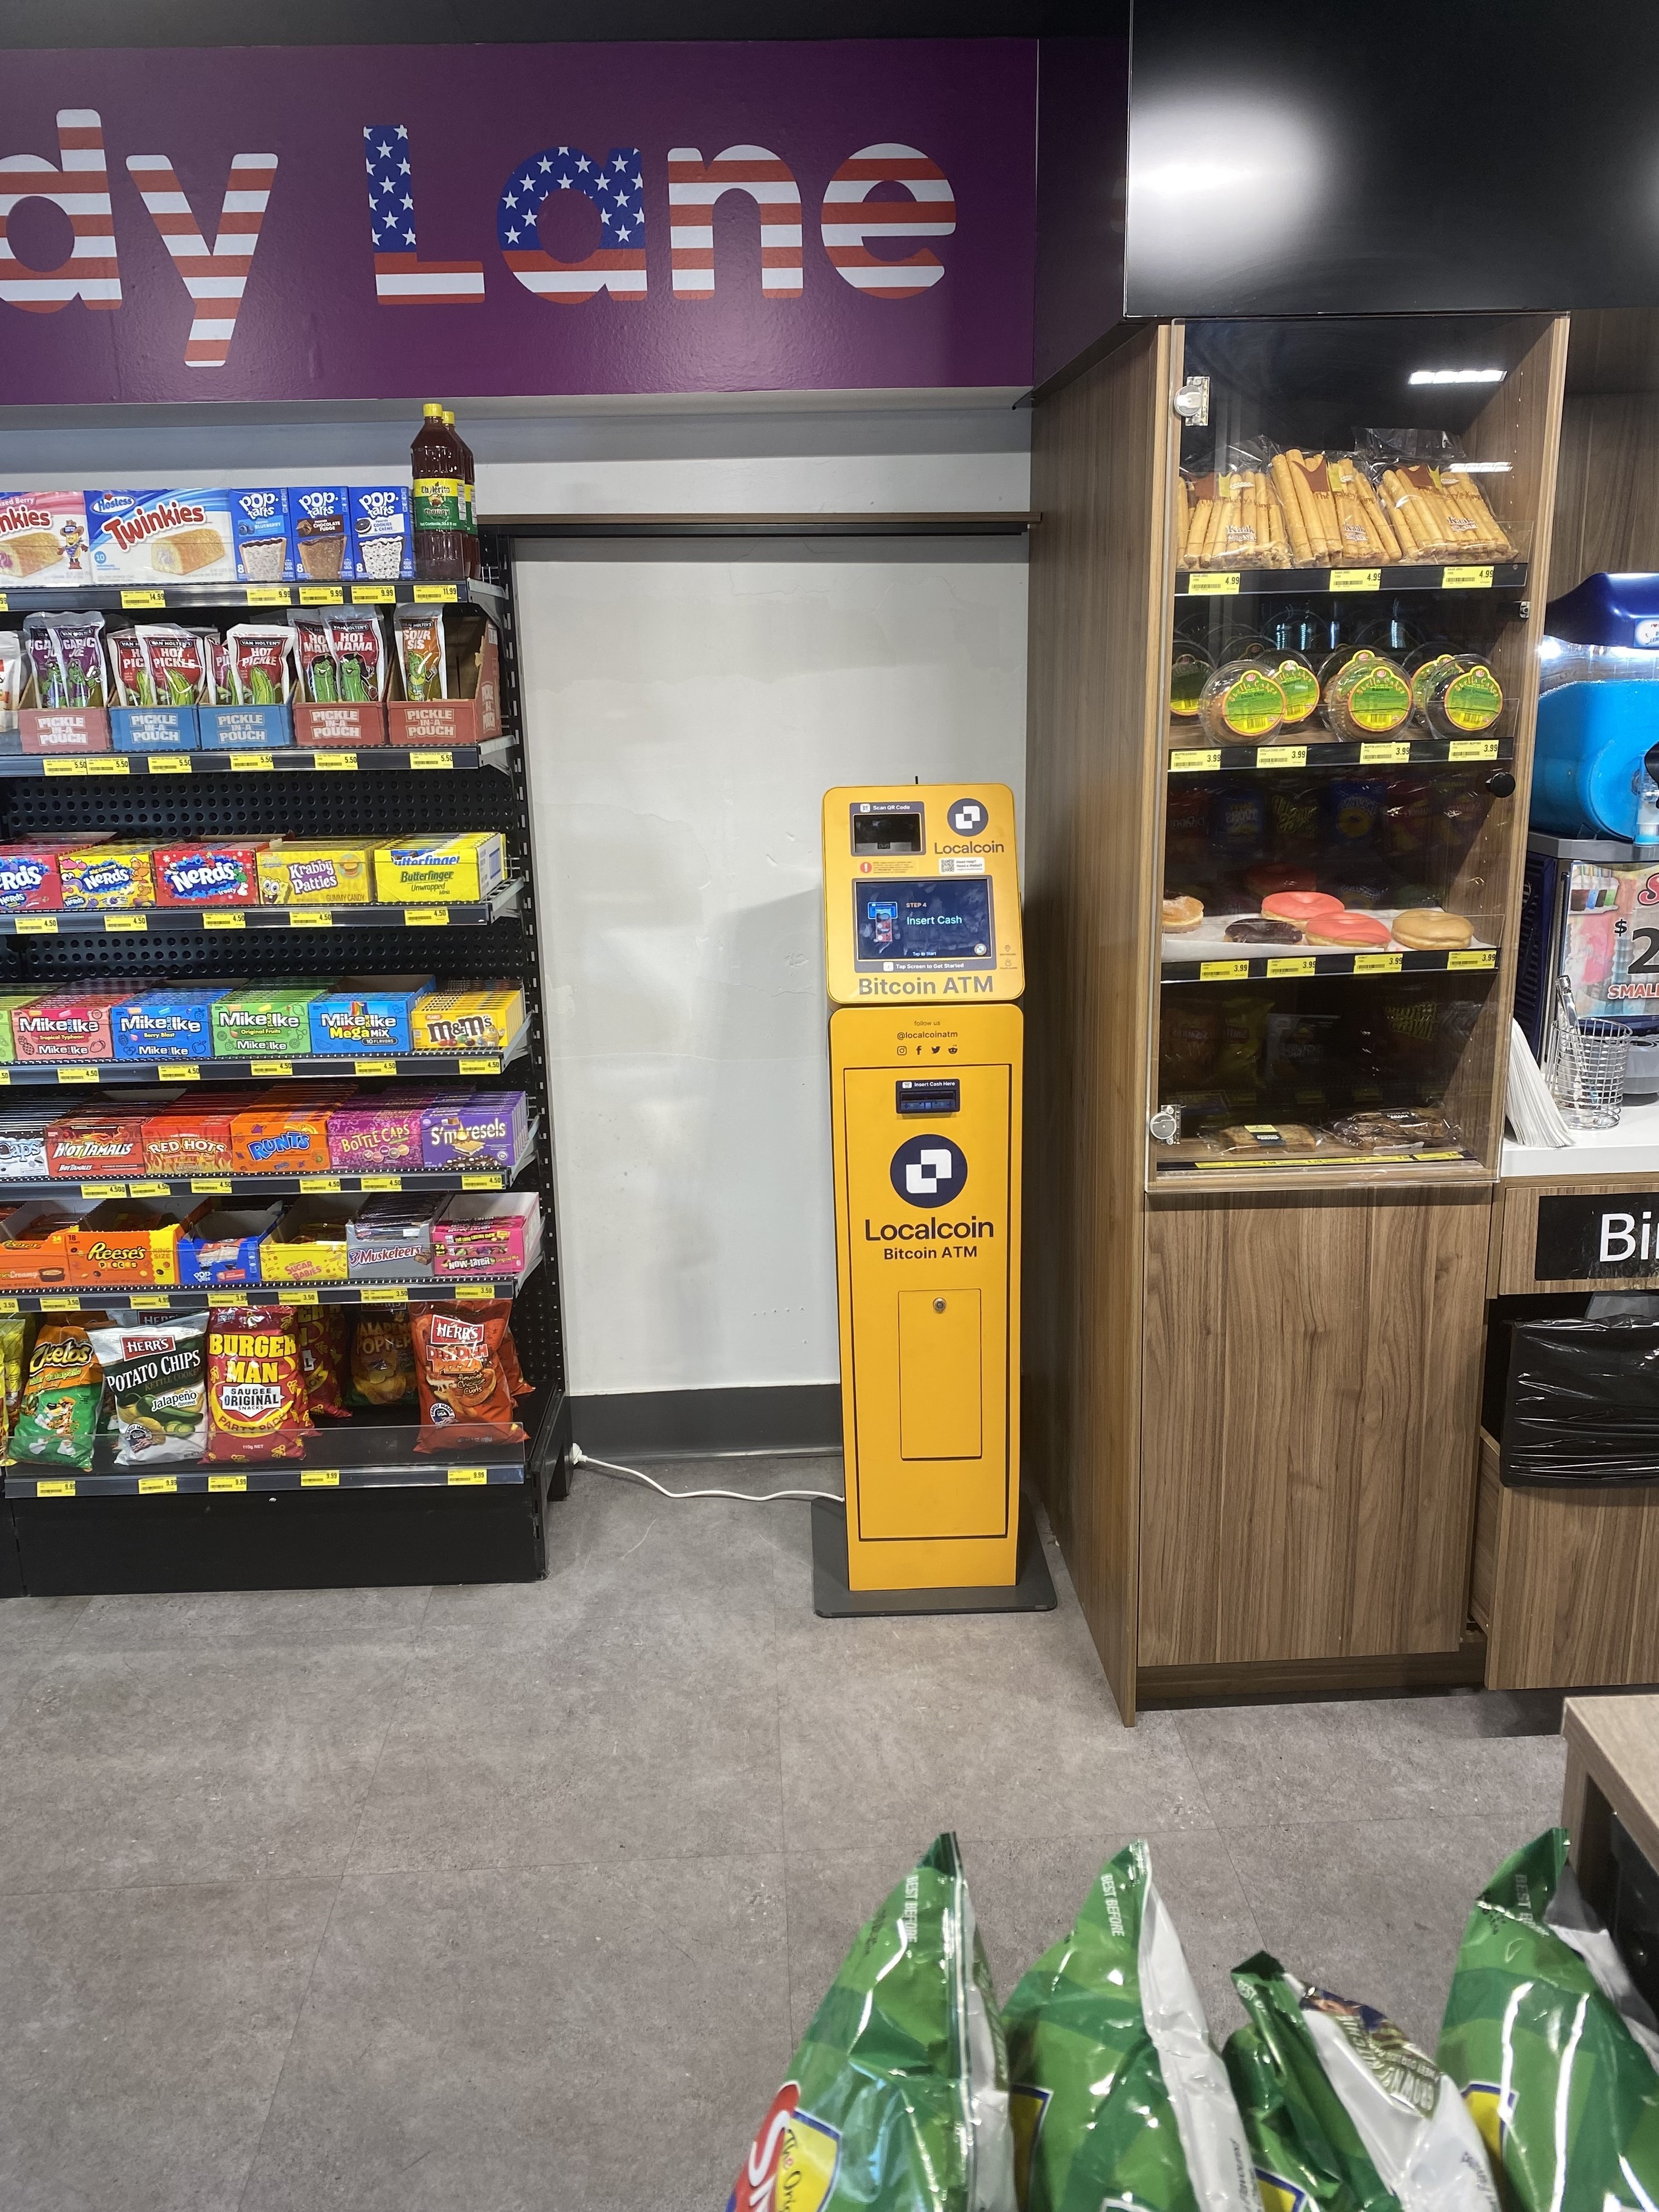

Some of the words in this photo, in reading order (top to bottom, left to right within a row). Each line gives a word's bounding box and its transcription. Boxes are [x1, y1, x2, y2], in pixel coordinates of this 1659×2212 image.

[0, 109, 278, 368] dy
[364, 124, 956, 304] Lane
[104, 502, 204, 550] Twinkies
[1345, 522, 1364, 532] Kaak
[238, 564, 244, 573] 8
[297, 564, 304, 572] 8
[356, 563, 363, 572] 8
[1479, 570, 1494, 578] 4.99
[340, 633, 364, 642] HOT
[403, 630, 431, 640] SOUR
[334, 642, 373, 652] MAMA
[407, 640, 424, 649] SIS
[251, 647, 274, 657] HOT
[37, 717, 84, 728] PICKLE
[40, 733, 87, 745] POUCH
[133, 731, 180, 742] POUCH
[219, 731, 265, 742] POUCH
[934, 840, 1005, 854] Localcoin
[288, 860, 334, 879] Krabby
[400, 870, 454, 883] Butterfinger
[293, 875, 337, 894] Patties
[411, 883, 445, 892] Unwrapped
[907, 916, 934, 925] Insert
[937, 916, 962, 924] Cash
[1614, 918, 1627, 937] $
[859, 977, 936, 995] Bitcoin
[943, 976, 994, 994] ATM
[19, 1017, 67, 1032] Mike
[74, 1018, 99, 1032] Ike
[121, 1017, 167, 1032] Mike
[171, 1016, 201, 1032] Ike
[219, 1012, 267, 1026] Mike
[272, 1012, 300, 1027] Ike
[321, 1014, 365, 1026] Mike
[371, 1014, 397, 1027] Ike
[427, 1016, 492, 1043] m&m's
[897, 1031, 958, 1040] @localcoinatm
[38, 1045, 67, 1054] Mike
[71, 1045, 88, 1054] Ike
[139, 1046, 167, 1055] Mike
[171, 1046, 188, 1055] Ike
[237, 1040, 266, 1050] Mike
[270, 1041, 287, 1050] Ike
[341, 1130, 381, 1152] BOTTLE
[381, 1124, 410, 1142] CAPS
[149, 1141, 180, 1153] RED
[184, 1139, 226, 1153] HOTS
[248, 1132, 310, 1161] RUNTS
[865, 1215, 994, 1241] Localcoin
[1600, 1211, 1659, 1262] Bi
[87, 1242, 146, 1261] Reese's
[349, 1251, 361, 1266] 3
[361, 1245, 421, 1264] Musketeers
[884, 1246, 937, 1260] Bitcoin
[941, 1246, 977, 1258] ATM
[285, 1261, 312, 1273] SUGAR
[292, 1266, 322, 1280] BABIES
[437, 1323, 478, 1340] HERR'S
[126, 1338, 169, 1353] HERR'S
[209, 1333, 296, 1357] BURGER
[106, 1362, 158, 1392] POTATO
[161, 1349, 200, 1376] CHIPS
[226, 1361, 278, 1383] MAN
[145, 1377, 172, 1392] KETTLE
[463, 1386, 482, 1395] Curls
[152, 1390, 197, 1411] Jalapeño
[224, 1395, 279, 1406] ORIGINAL
[218, 1416, 257, 1431] PARTY
[906, 1874, 919, 1900] BEST
[1100, 1873, 1117, 1901] BEST
[1515, 1875, 1531, 1909] BEST
[905, 1900, 918, 1943] BEFORE
[1106, 1900, 1124, 1937] BEFORE
